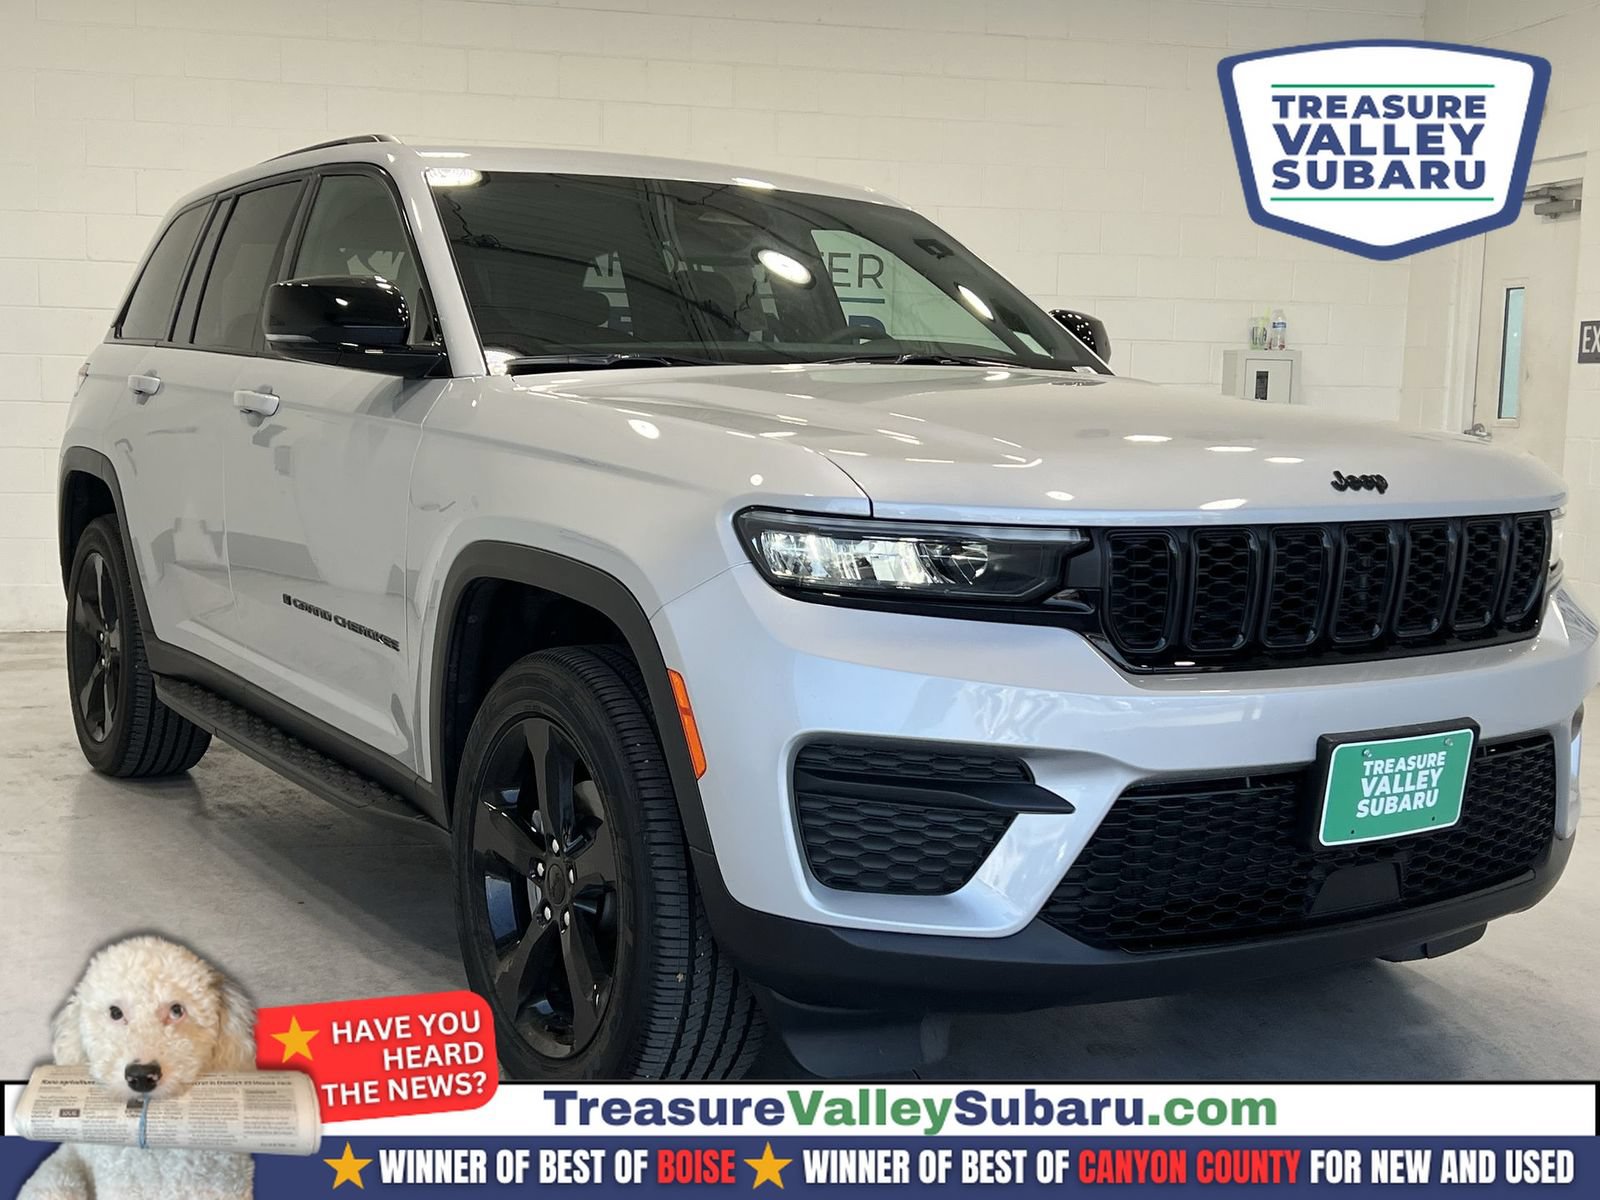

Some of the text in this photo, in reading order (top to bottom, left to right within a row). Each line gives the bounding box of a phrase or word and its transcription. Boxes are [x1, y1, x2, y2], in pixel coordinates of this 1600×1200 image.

[820, 251, 884, 289] ER
[1330, 470, 1389, 495] Jeep
[333, 614, 400, 652] CHEROKEE
[1362, 750, 1448, 777] TREASURE
[1360, 767, 1445, 798] VALLEY
[1355, 788, 1440, 819] SUBARU
